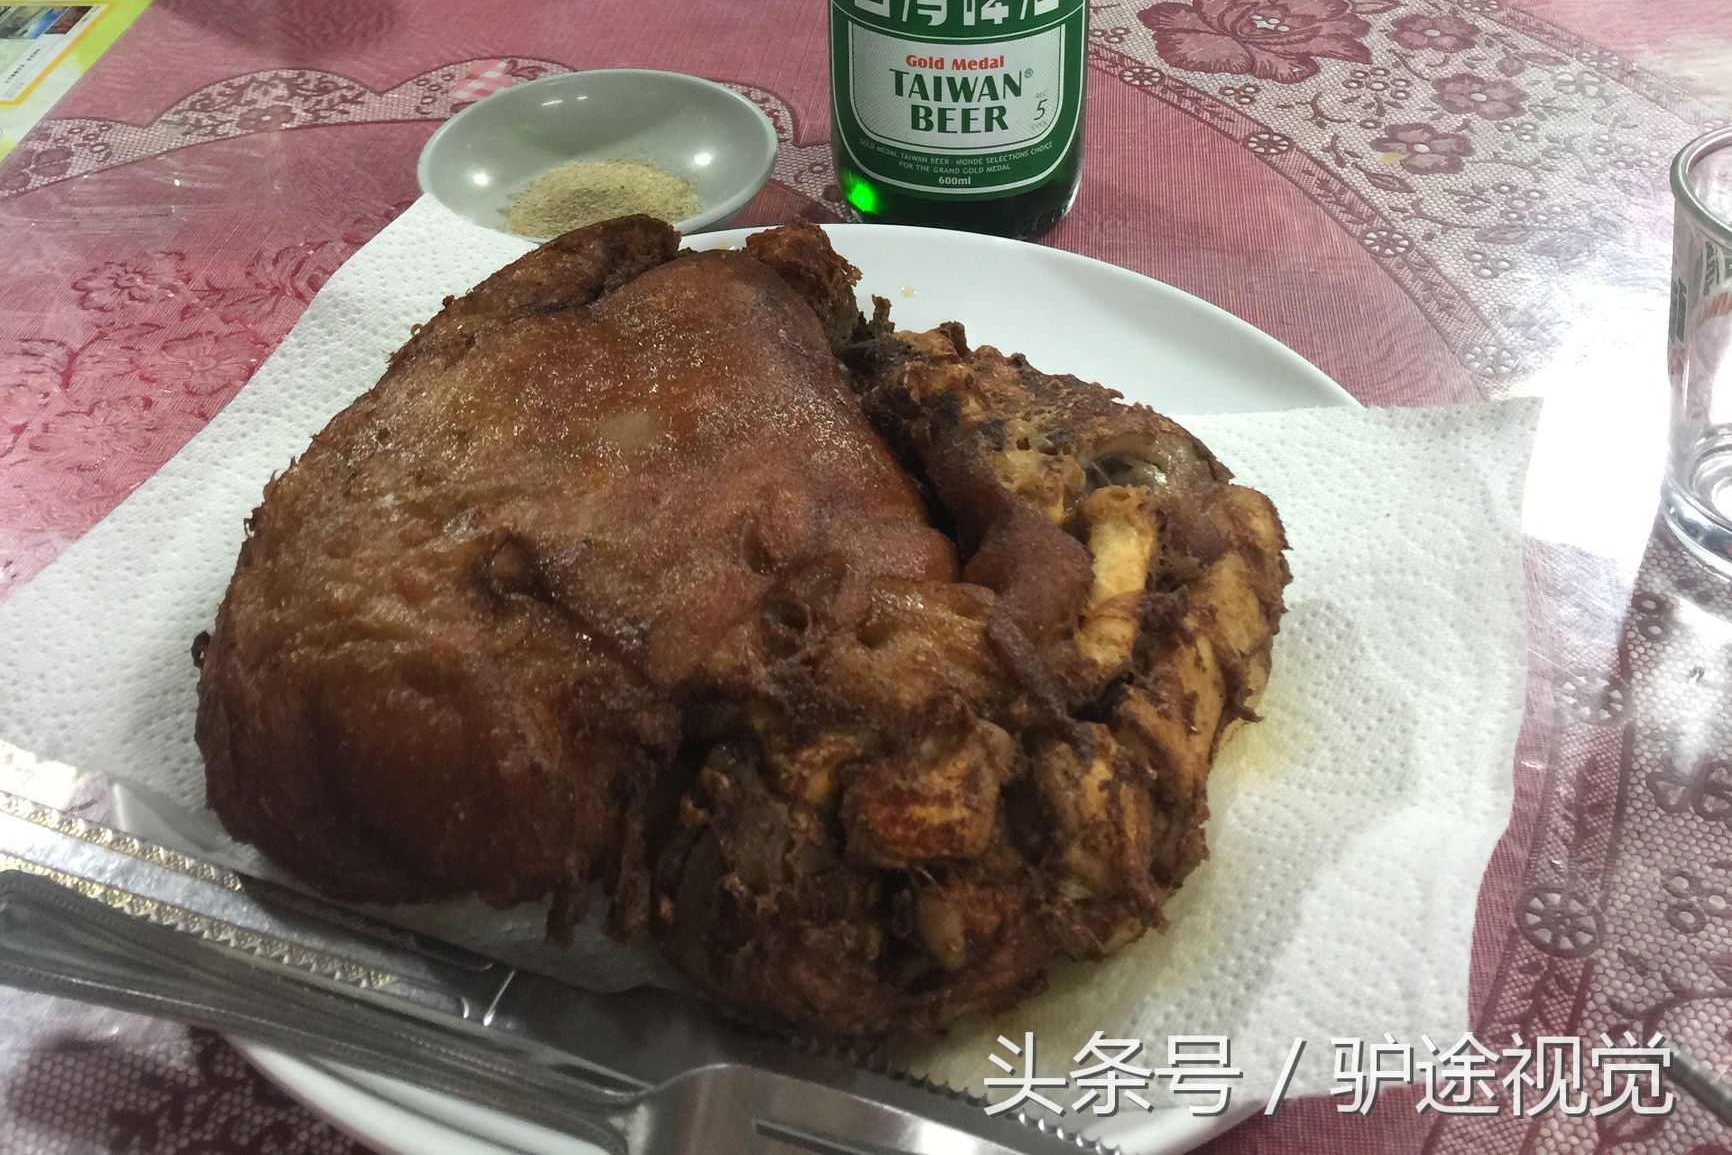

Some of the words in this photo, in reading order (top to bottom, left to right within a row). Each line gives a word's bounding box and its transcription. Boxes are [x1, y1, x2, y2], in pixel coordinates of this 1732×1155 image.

[905, 54, 945, 71] Gold
[951, 55, 1005, 71] Medal
[889, 68, 1023, 103] TAIWAN
[911, 104, 1009, 134] BEER
[1033, 98, 1048, 121] 5
[877, 146, 898, 159] MEDAL
[901, 152, 928, 163] TAIWAN
[930, 157, 950, 165] BEER
[956, 156, 983, 165] MONDE
[986, 149, 1029, 164] SELECTIONS
[1030, 140, 1053, 155] CHOICE
[899, 160, 914, 170] FOR
[916, 163, 931, 172] THE
[933, 166, 960, 175] GRAND
[962, 165, 984, 174] GOLD
[986, 163, 1011, 173] MEDAL
[938, 175, 972, 186] 600ml
